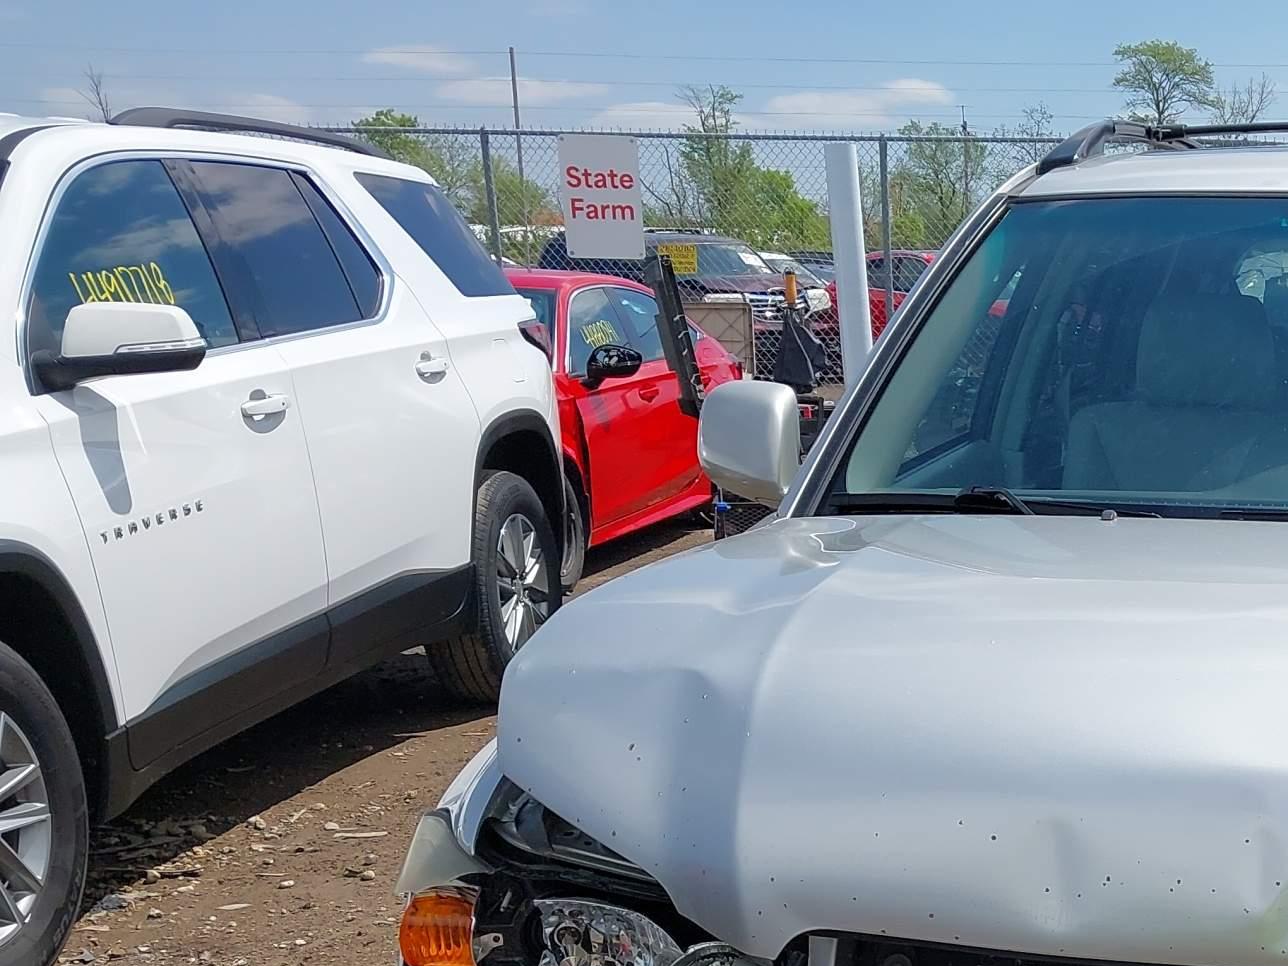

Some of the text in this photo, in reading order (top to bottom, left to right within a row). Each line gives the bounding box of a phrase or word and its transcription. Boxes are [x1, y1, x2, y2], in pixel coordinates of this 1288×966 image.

[566, 166, 634, 189] State
[570, 198, 635, 220] Farm
[100, 500, 203, 544] TRAVERSE
